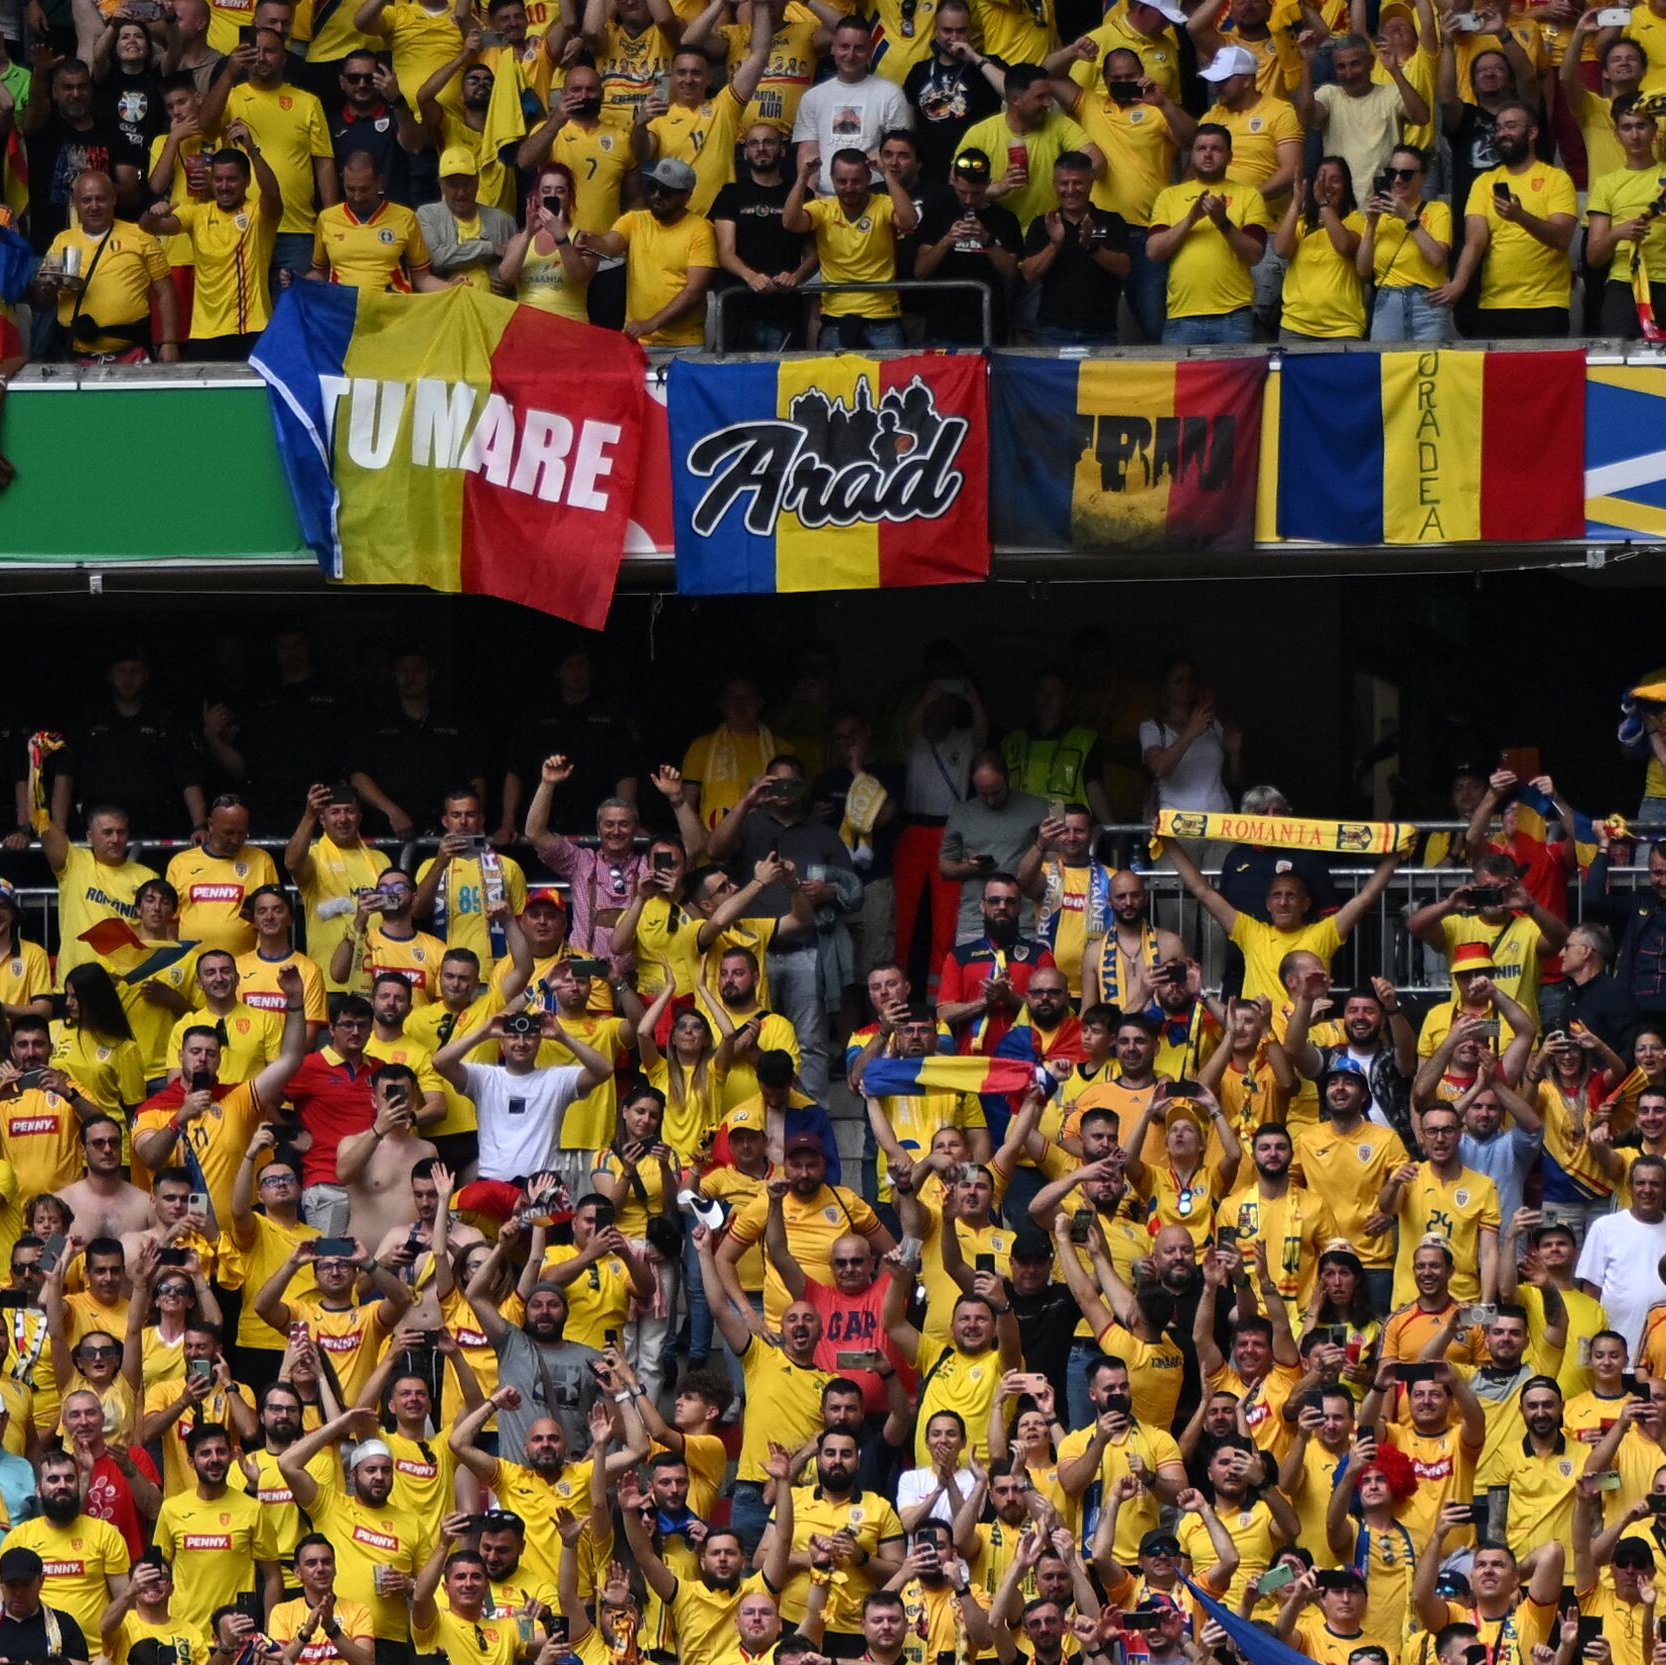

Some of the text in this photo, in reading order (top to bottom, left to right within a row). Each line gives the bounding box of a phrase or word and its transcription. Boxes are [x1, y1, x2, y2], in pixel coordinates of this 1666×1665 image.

[585, 157, 598, 181] 7
[412, 378, 623, 513] MARE
[1415, 350, 1446, 541] ORADEA
[687, 416, 968, 538] Arad
[1219, 818, 1324, 847] ROMANIA
[245, 995, 287, 1009] PENNY
[12, 1120, 56, 1134] PENNY.
[826, 1310, 878, 1342] GAP
[186, 1537, 228, 1549] PENNY.
